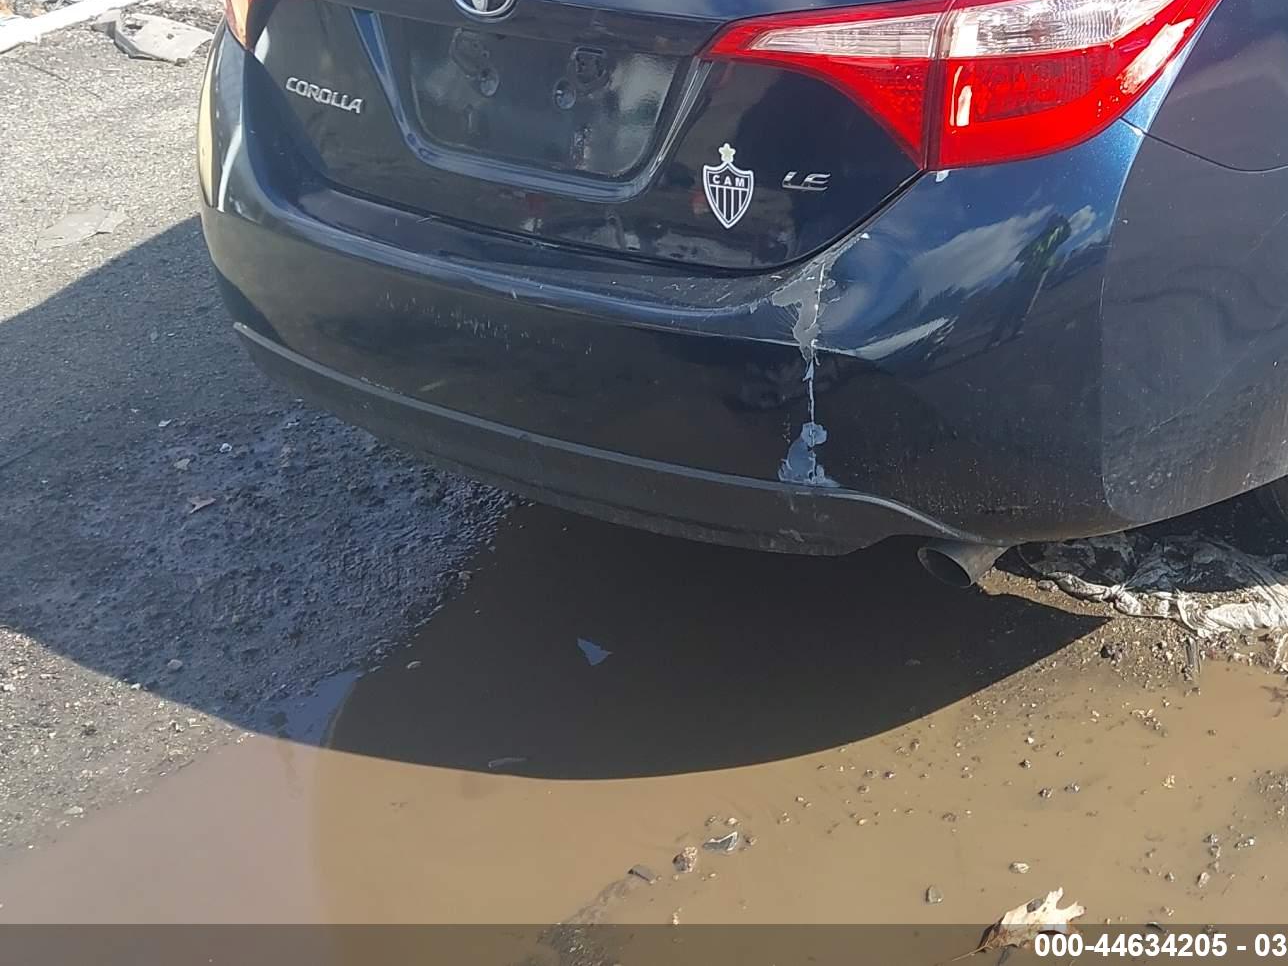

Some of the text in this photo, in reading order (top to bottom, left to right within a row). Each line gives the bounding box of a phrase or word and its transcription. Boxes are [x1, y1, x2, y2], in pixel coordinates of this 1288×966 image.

[285, 76, 363, 114] COROLLA
[712, 174, 745, 188] CAM
[781, 171, 832, 191] LE
